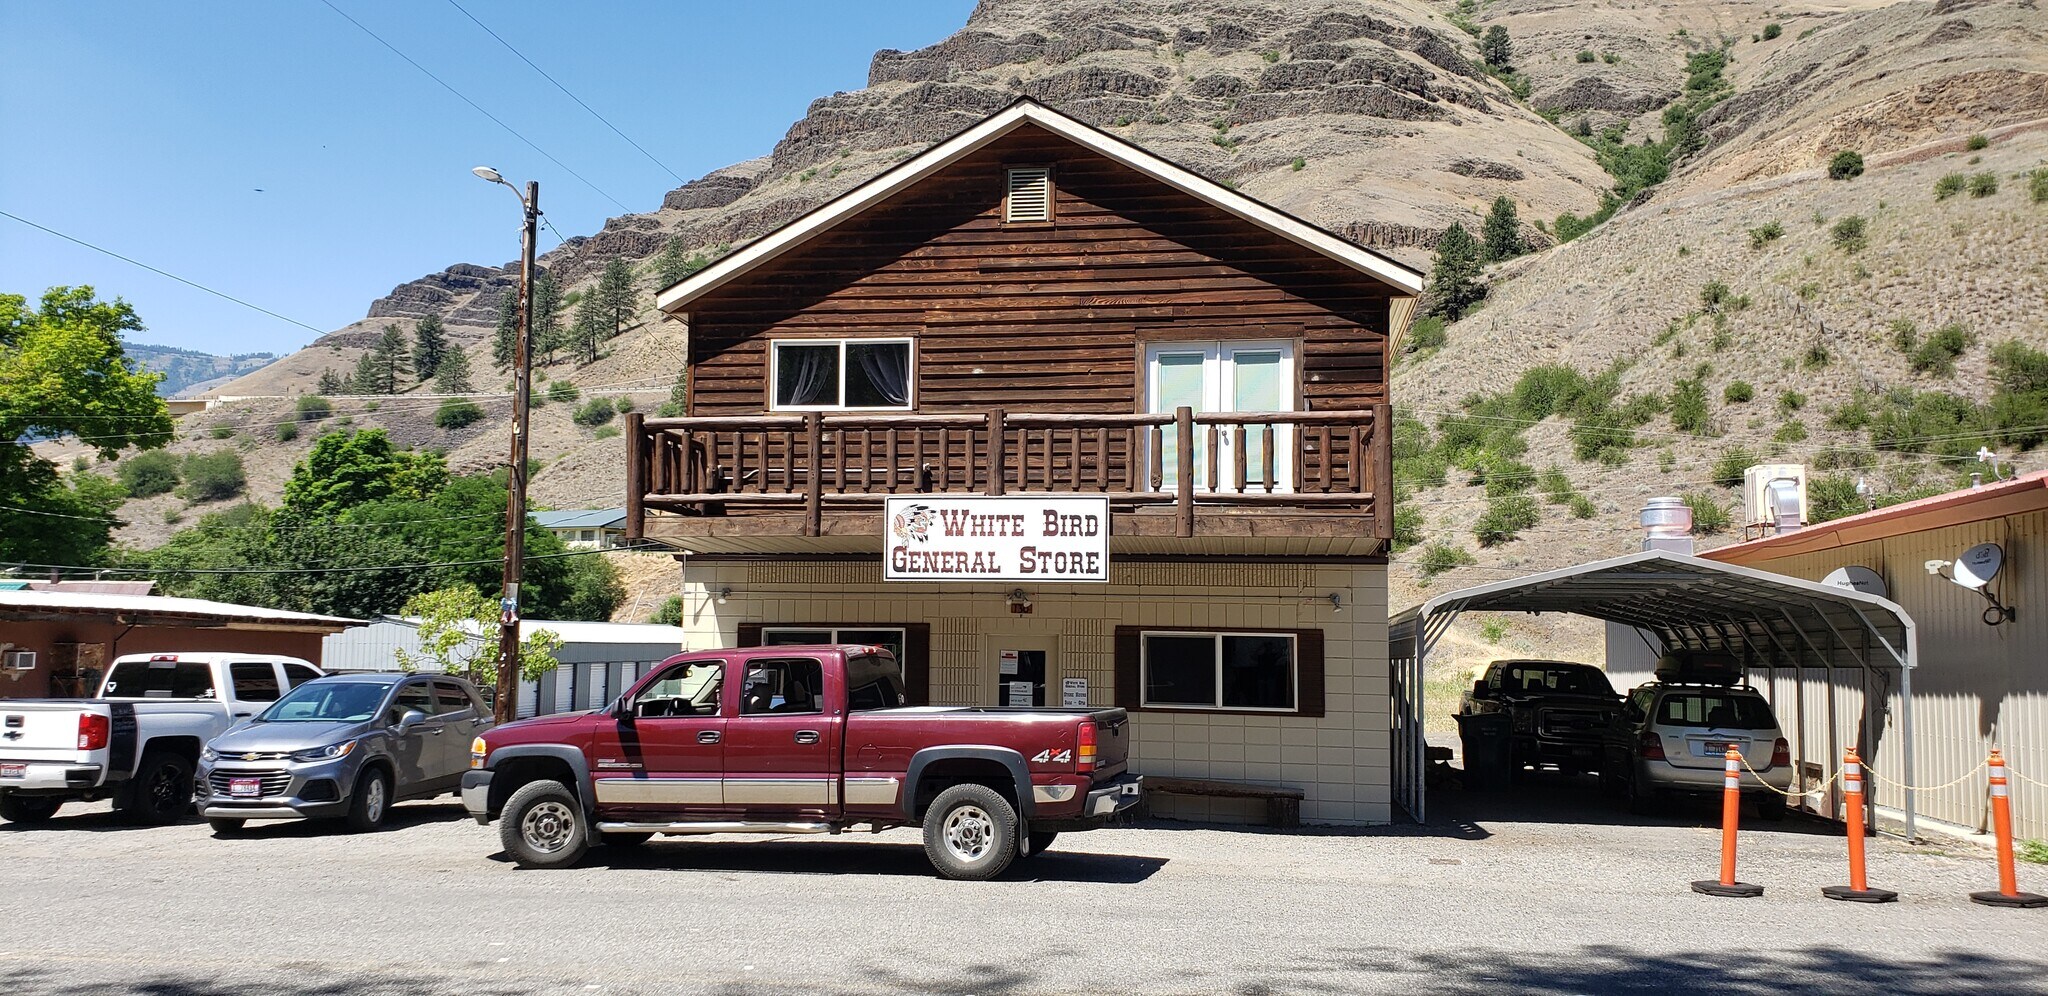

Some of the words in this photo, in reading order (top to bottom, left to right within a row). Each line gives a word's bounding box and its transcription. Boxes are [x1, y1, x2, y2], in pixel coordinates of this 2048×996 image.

[940, 509, 1025, 537] WHITE
[1042, 509, 1099, 537] BIRD
[892, 545, 1001, 573] GENERAL
[1019, 546, 1099, 574] STORE
